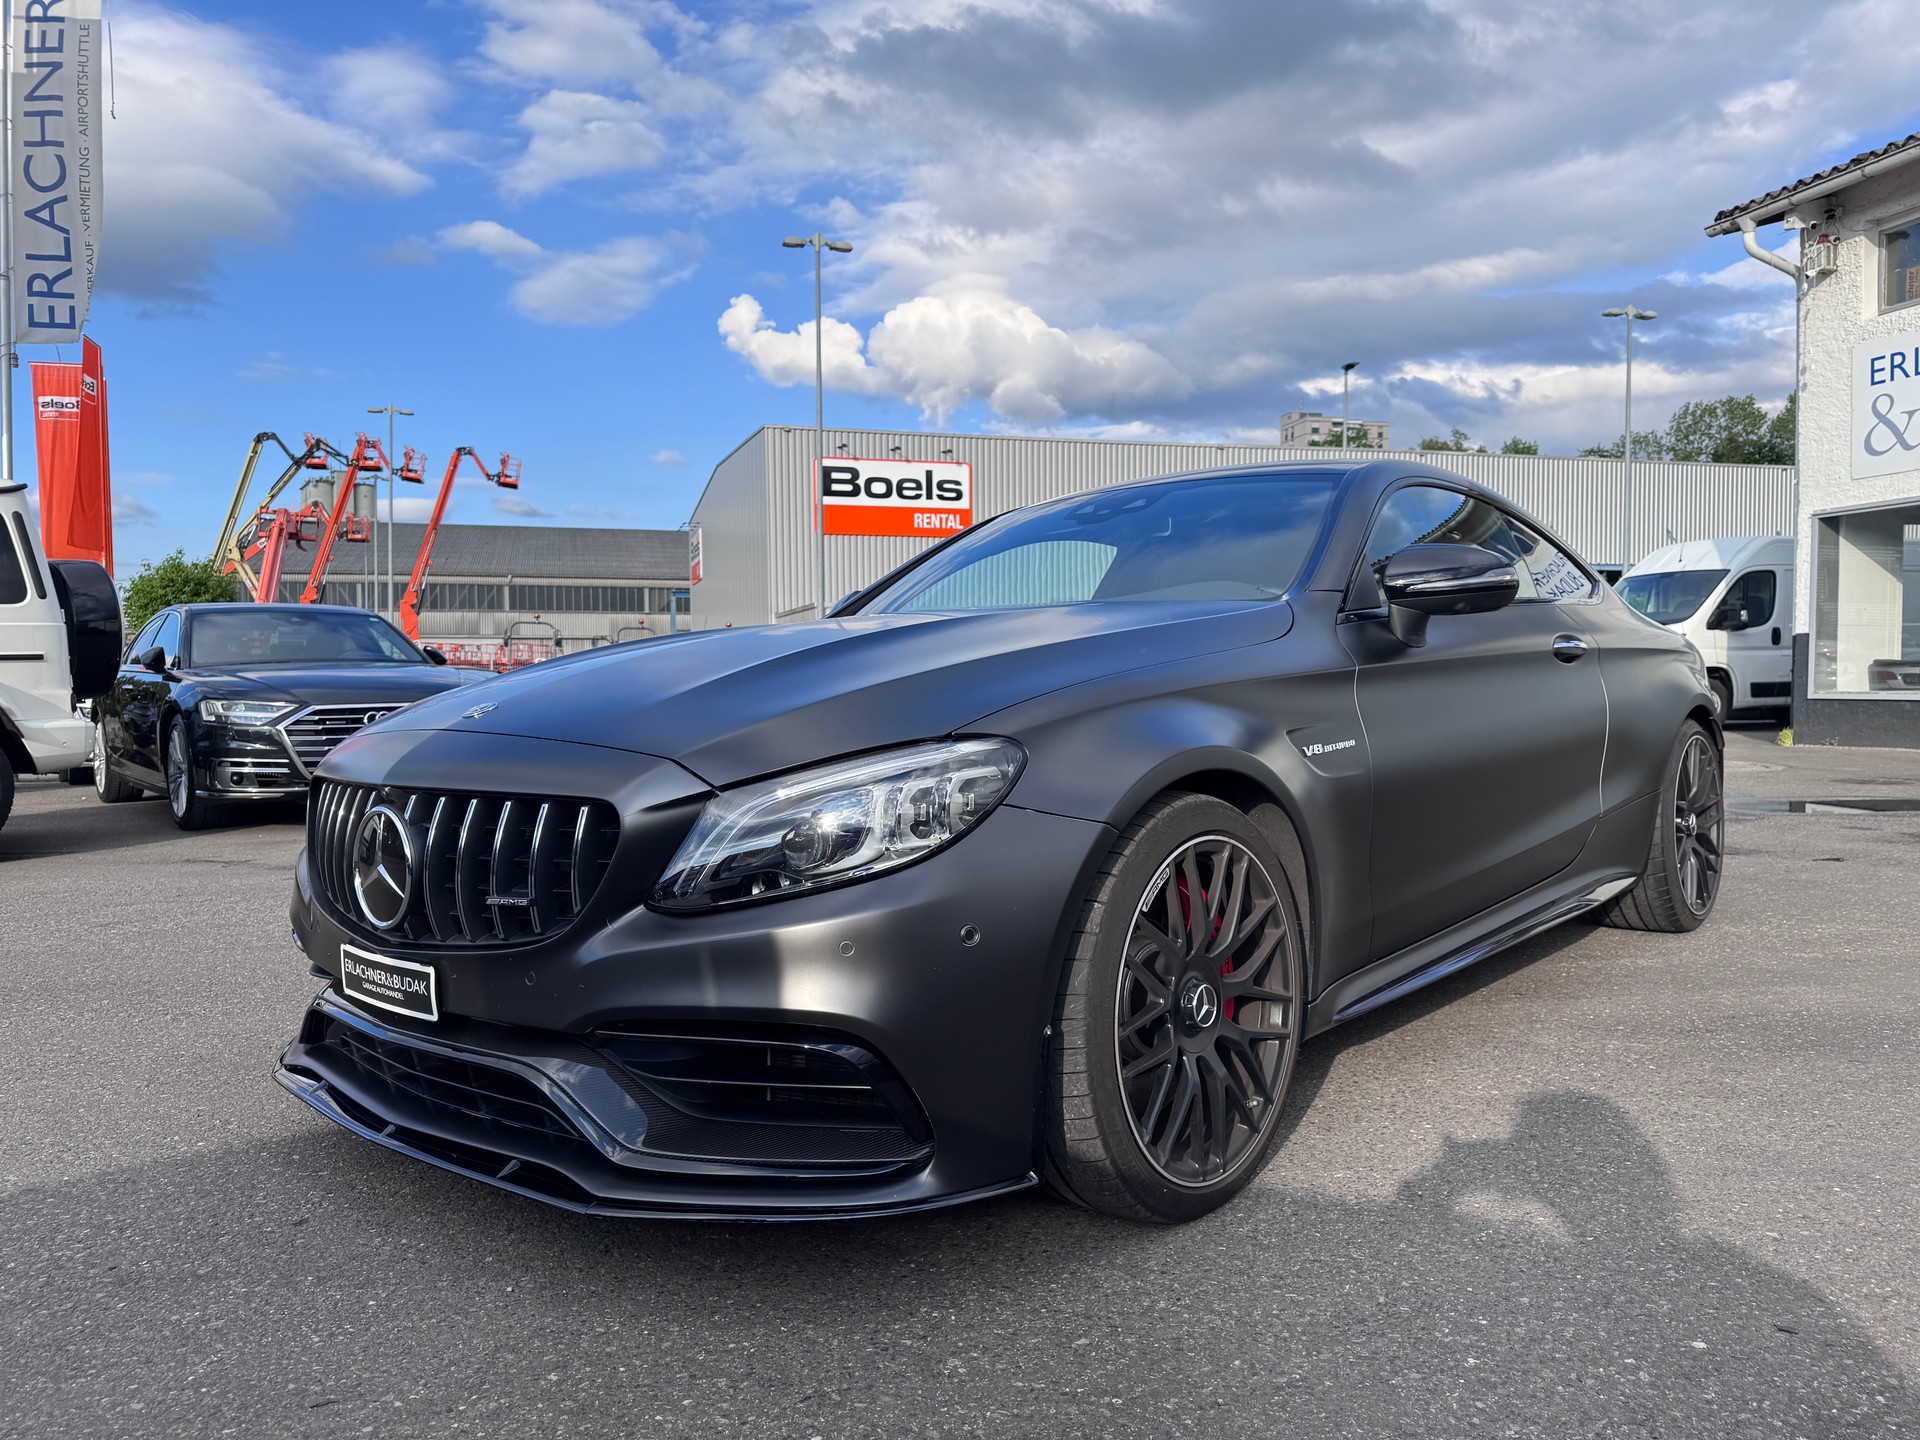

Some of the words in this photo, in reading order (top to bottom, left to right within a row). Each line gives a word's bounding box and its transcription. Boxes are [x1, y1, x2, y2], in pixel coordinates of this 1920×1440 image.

[76, 23, 91, 137] AIRPORTSHUTTLE
[23, 0, 76, 330] ERLACHNER
[78, 146, 92, 232] VERMIETUNG
[1863, 393, 1920, 457] &
[822, 466, 964, 501] Boels
[913, 513, 964, 530] RENTAL
[1302, 743, 1323, 757] V8
[499, 898, 528, 906] AMG
